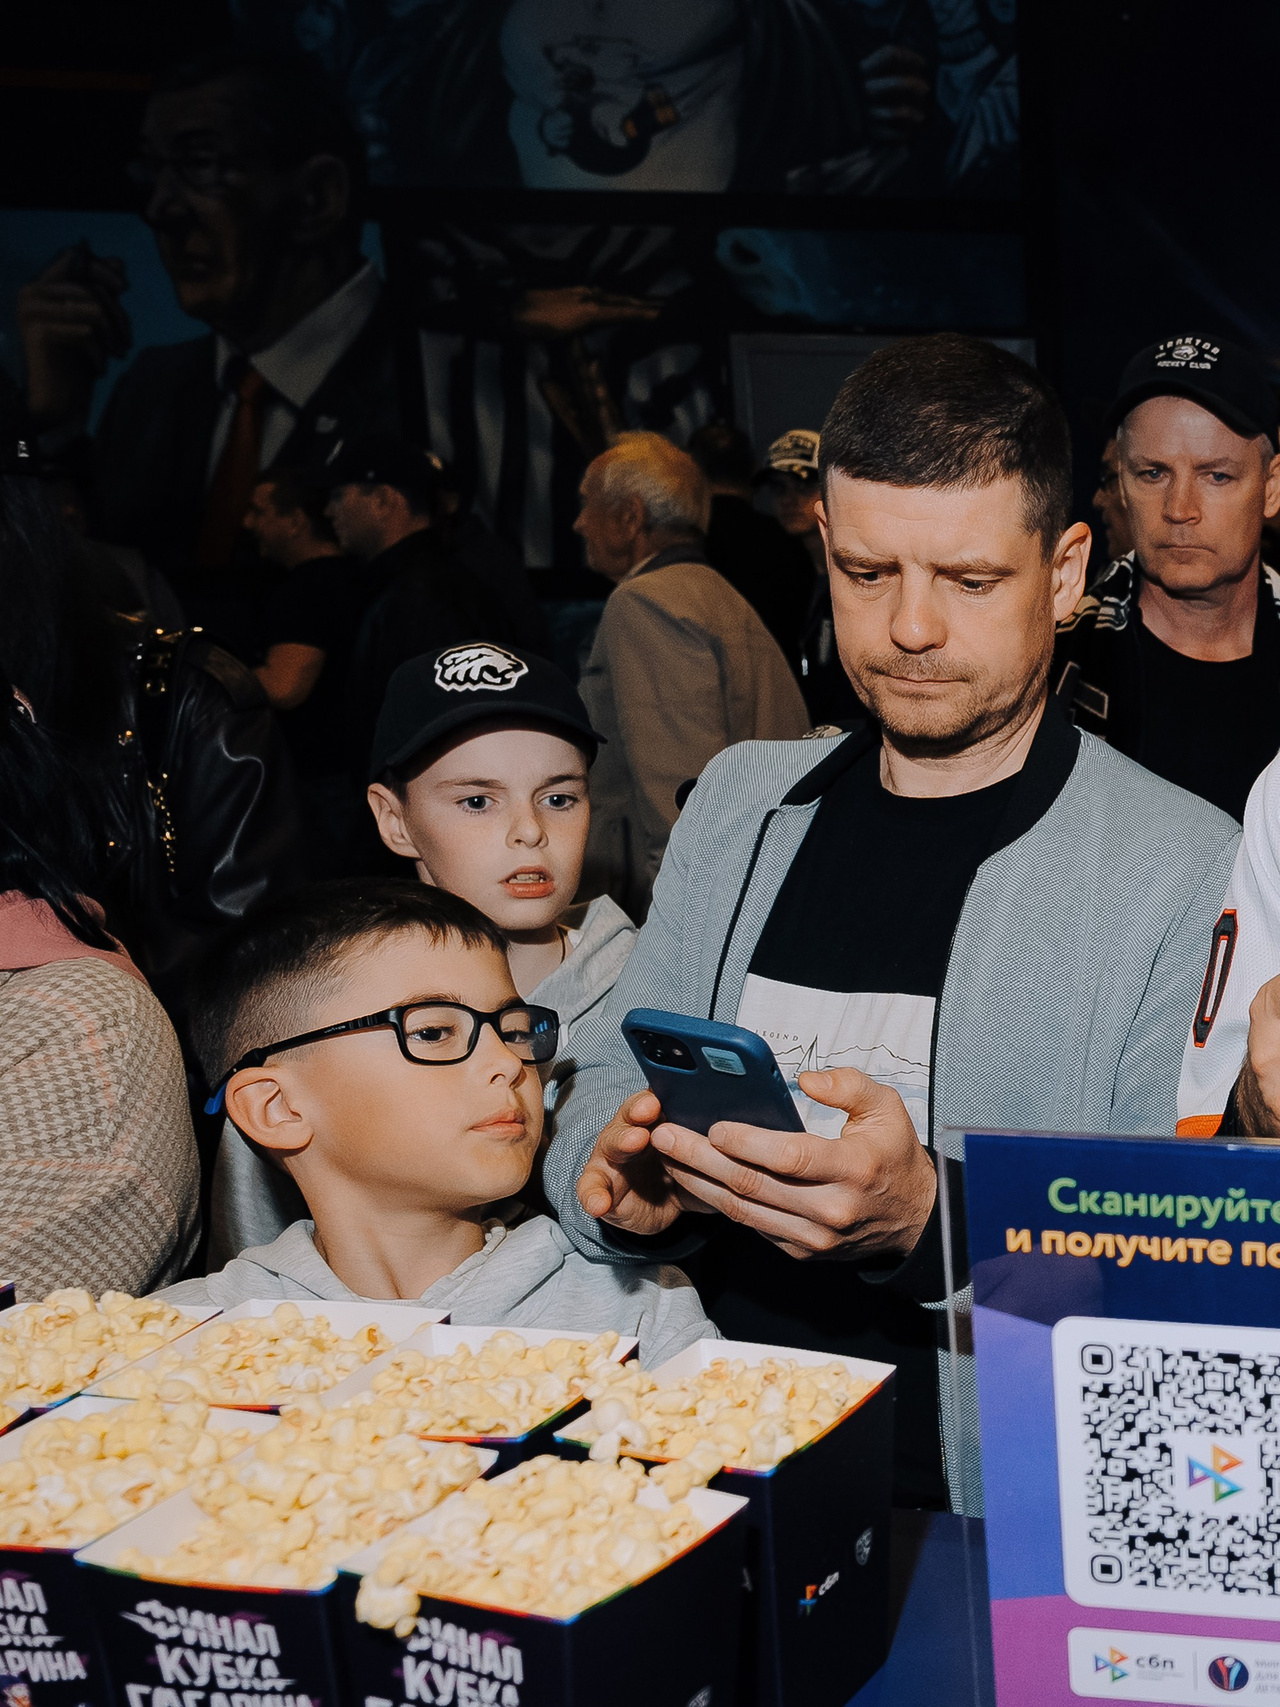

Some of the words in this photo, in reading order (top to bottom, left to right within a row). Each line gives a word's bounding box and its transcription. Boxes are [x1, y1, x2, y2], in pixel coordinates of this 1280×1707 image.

[1005, 1227, 1032, 1254] и
[1041, 1229, 1233, 1268] получите
[119, 1599, 281, 1656] ФИНАЛ
[154, 1644, 297, 1691] КУБКА
[1136, 1654, 1174, 1670] сбп
